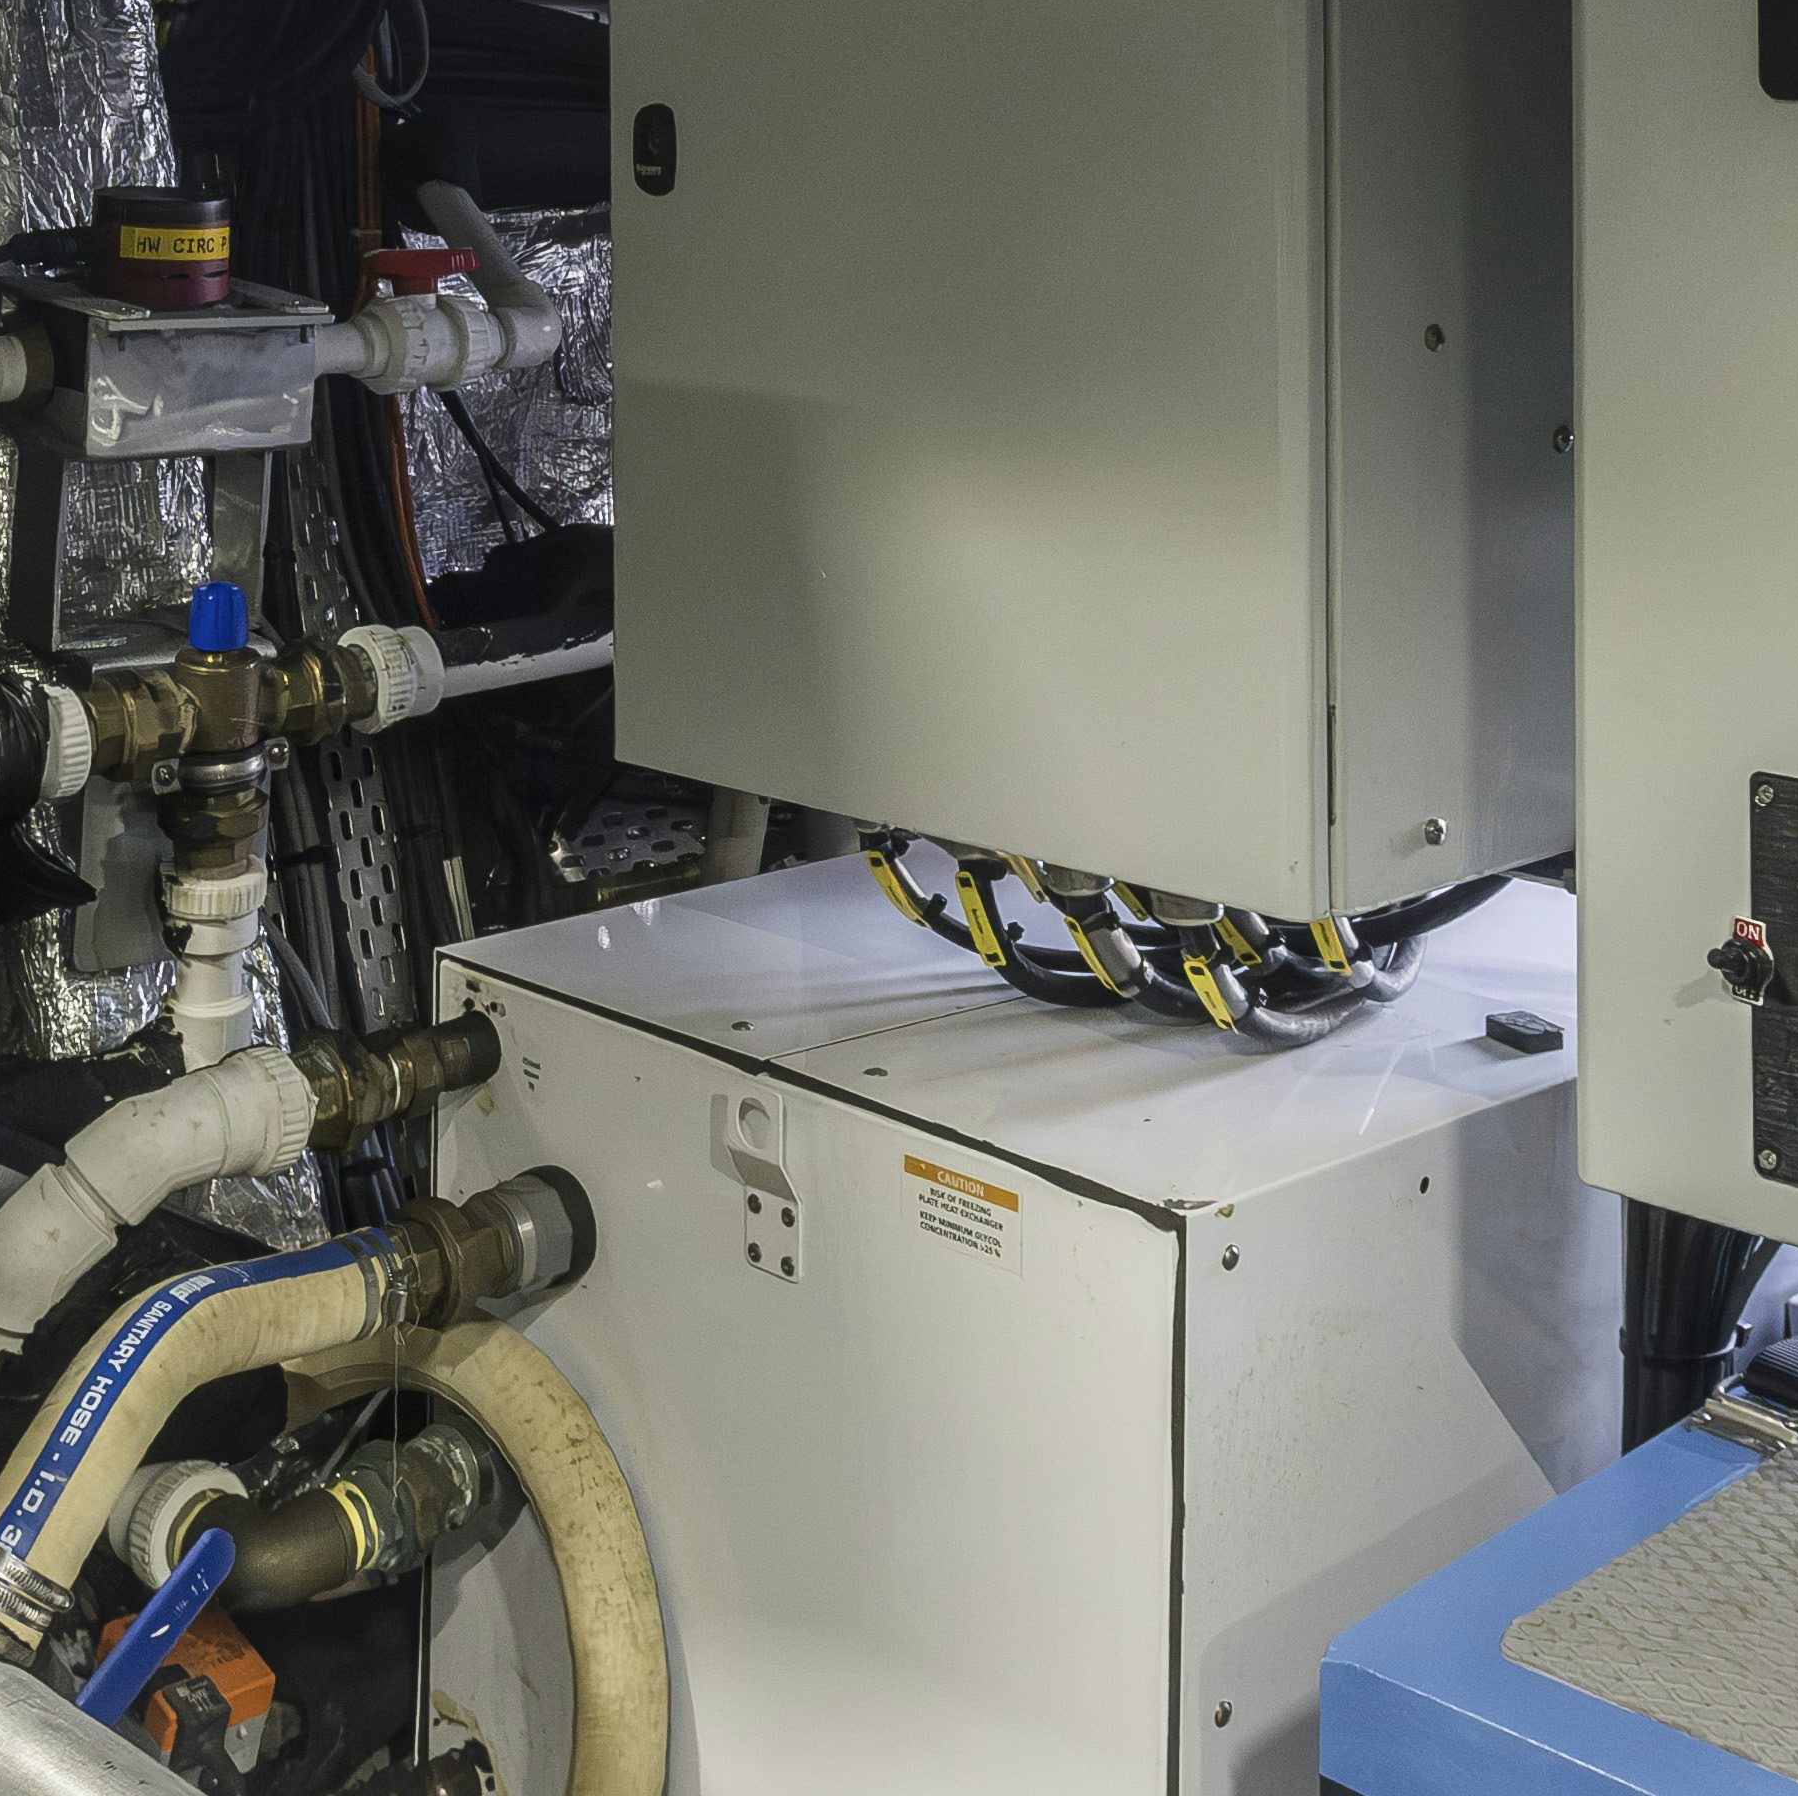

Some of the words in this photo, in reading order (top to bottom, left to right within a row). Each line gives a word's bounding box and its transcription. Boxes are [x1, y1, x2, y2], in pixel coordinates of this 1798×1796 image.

[136, 235, 162, 254] HW
[172, 235, 216, 254] CIRC
[1736, 922, 1760, 940] ON
[937, 1171, 984, 1196] CAUTION
[919, 1193, 939, 1208] PLATE
[941, 1202, 958, 1214] HEAT
[960, 1209, 1003, 1231] EXCHANGER
[930, 1188, 945, 1199] RISK
[947, 1195, 957, 1203] OF
[959, 1198, 991, 1216] FREEZING
[920, 1210, 937, 1222] KEEP
[938, 1217, 973, 1237] MINIMUM
[975, 1231, 1002, 1248] GLYCOL
[920, 1221, 978, 1250] CONCENTRATION
[108, 1300, 173, 1373] SANITARY
[59, 1375, 113, 1447] HOSE
